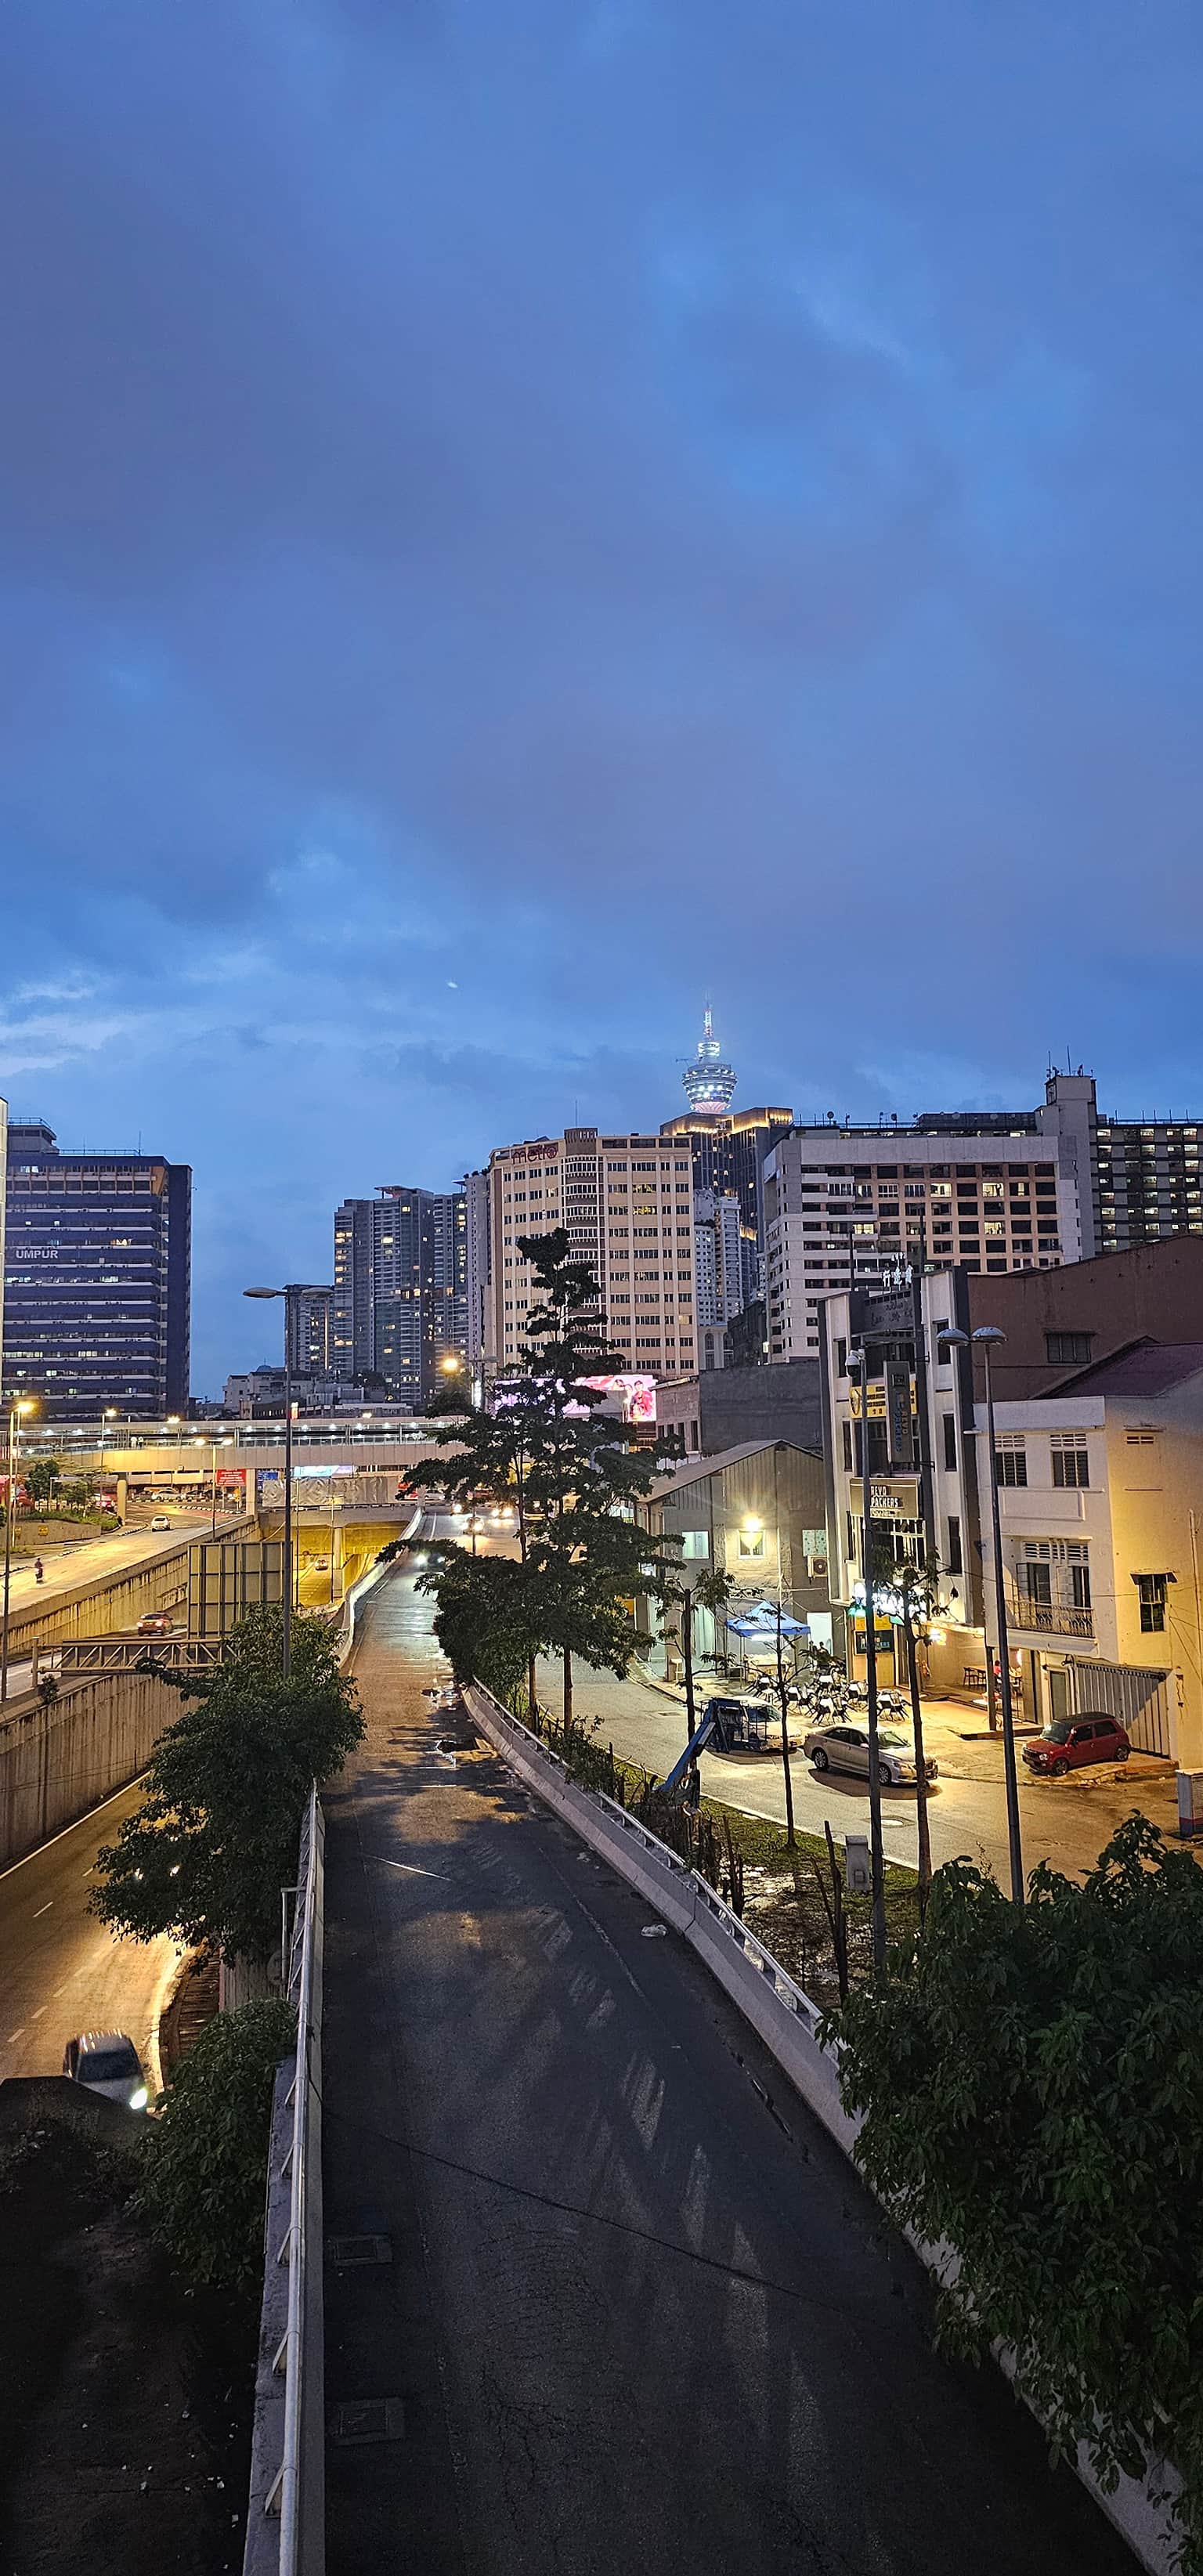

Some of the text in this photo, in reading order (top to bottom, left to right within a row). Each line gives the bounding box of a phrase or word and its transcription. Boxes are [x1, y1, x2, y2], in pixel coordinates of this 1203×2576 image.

[511, 1144, 558, 1165] metro
[16, 1249, 59, 1259] UMPUR
[870, 1485, 887, 1496] REVO
[870, 1497, 899, 1508] PACKERS
